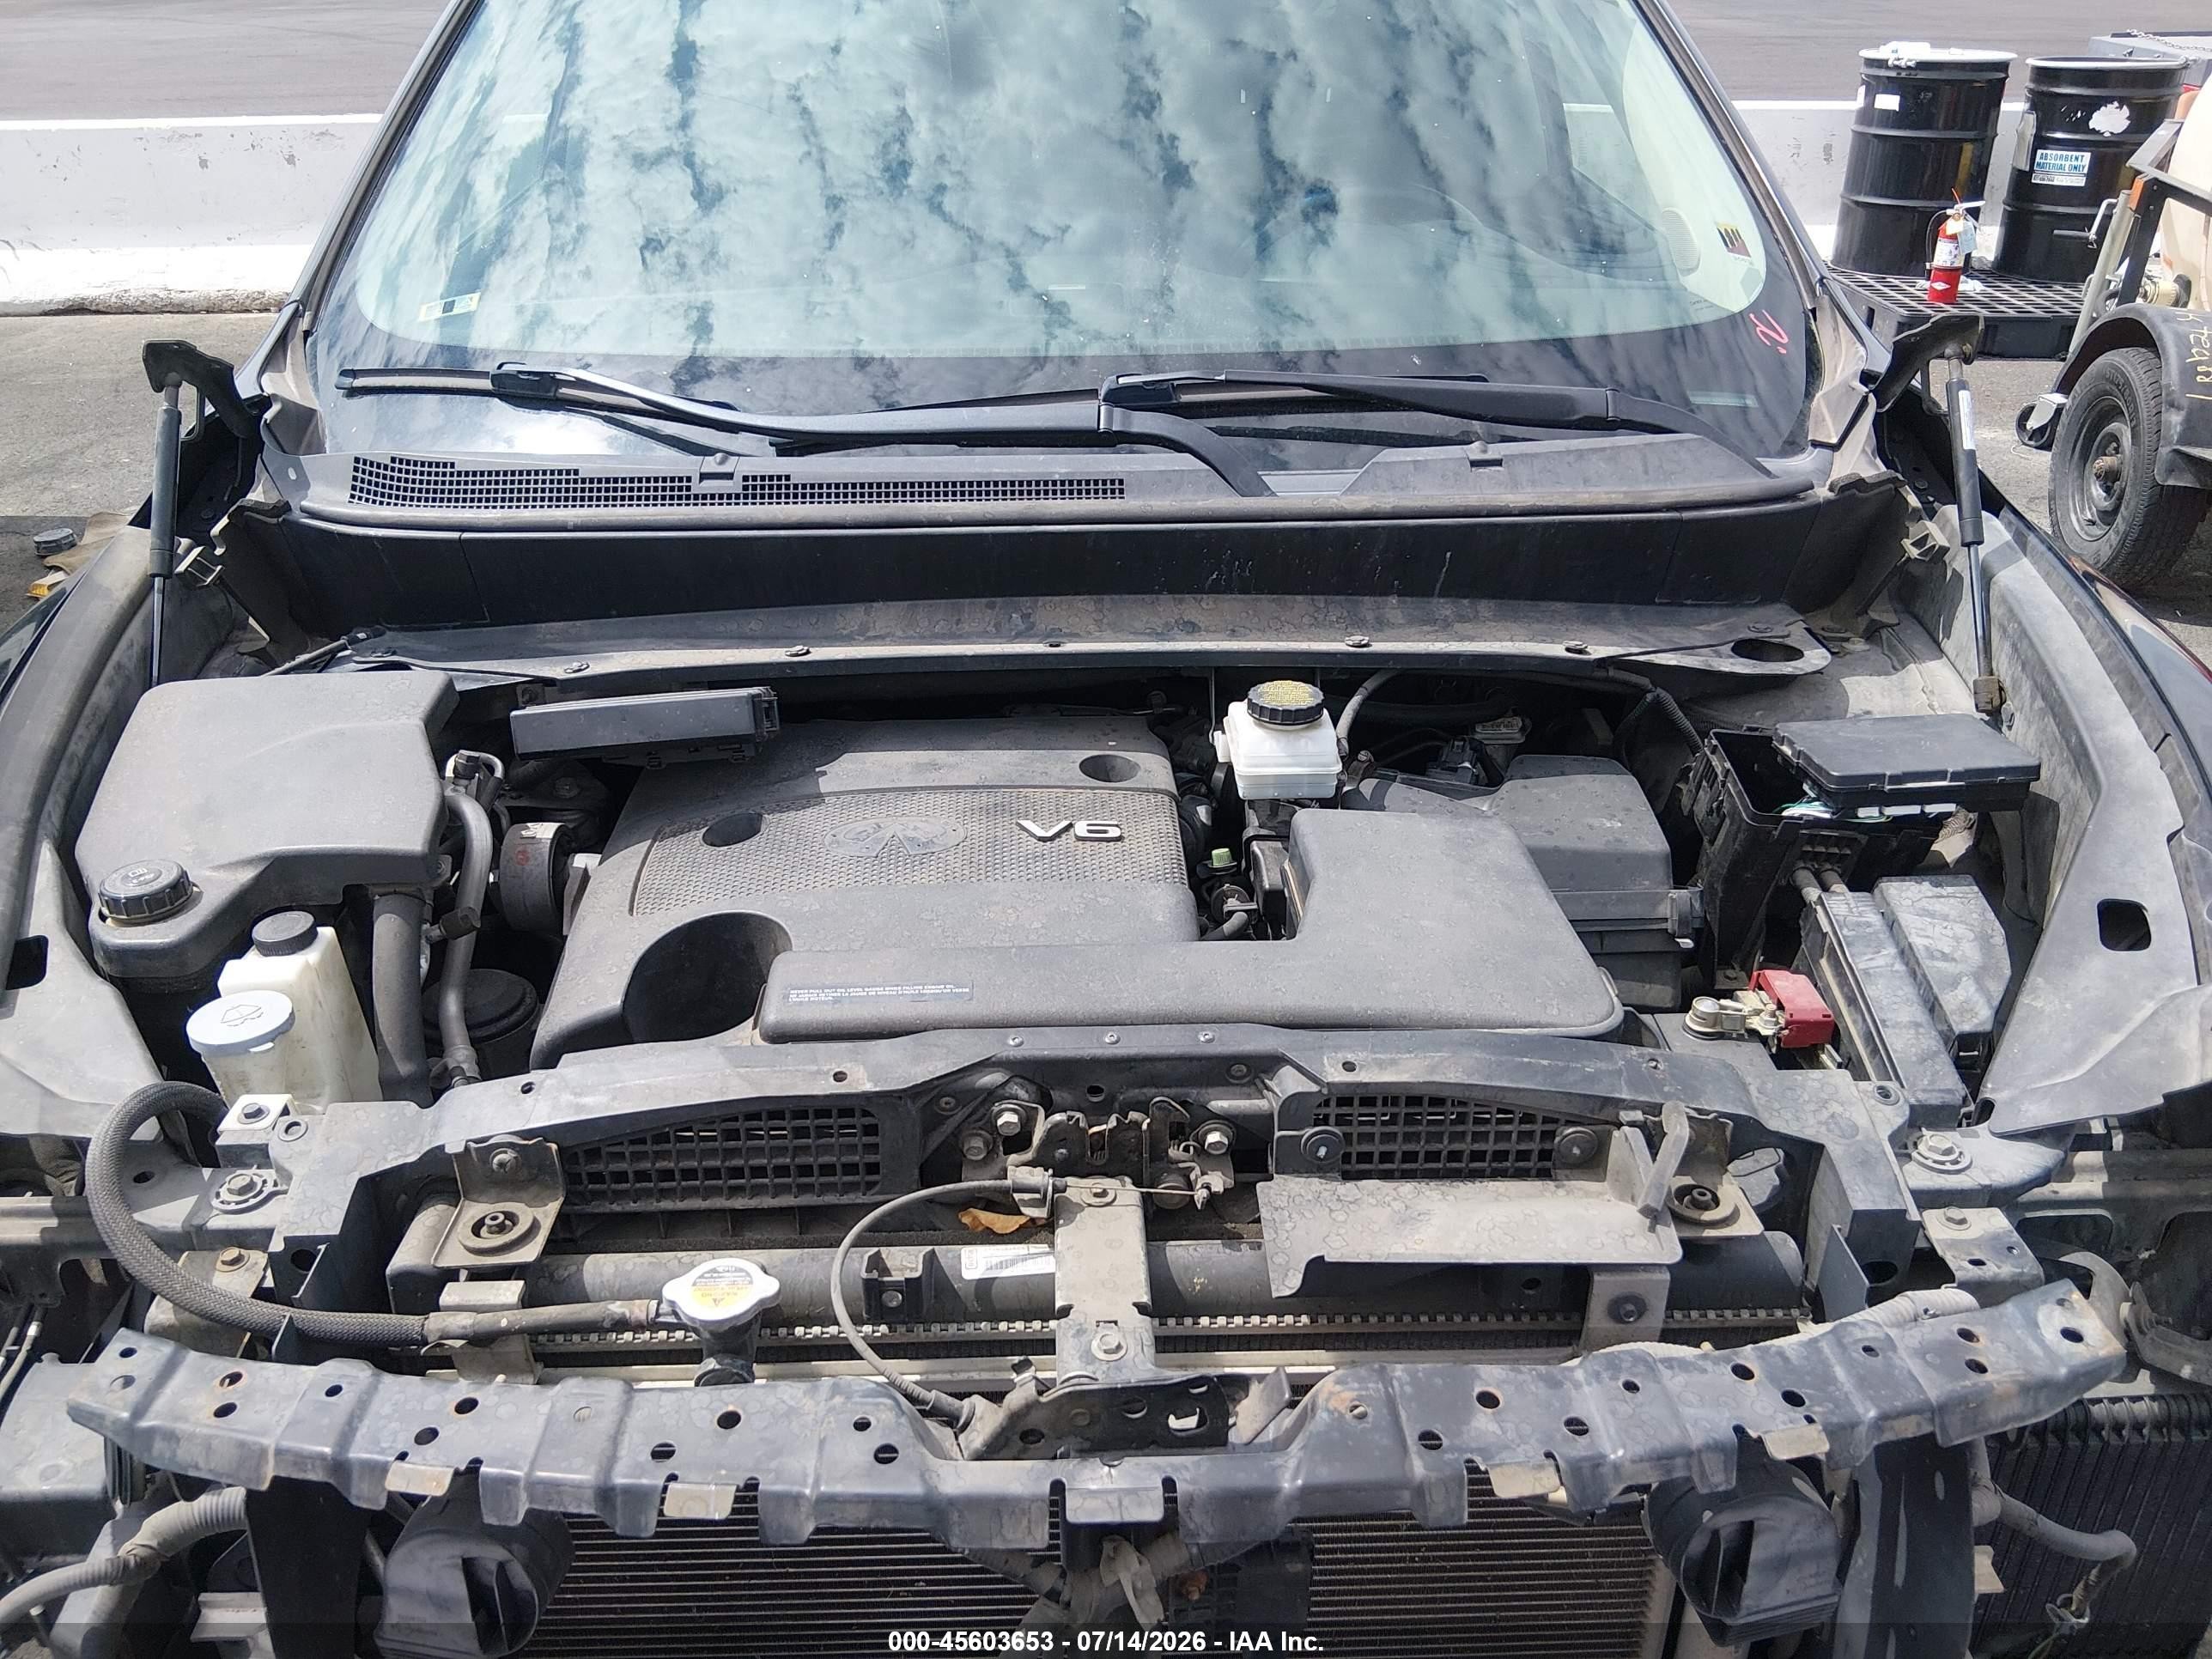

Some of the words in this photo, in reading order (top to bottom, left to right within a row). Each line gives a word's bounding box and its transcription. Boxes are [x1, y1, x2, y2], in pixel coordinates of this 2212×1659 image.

[2039, 152, 2085, 162] ABSORBENT
[2035, 161, 2066, 172] MATERIAL
[2068, 163, 2087, 172] ONLY
[1017, 819, 1125, 843] V6
